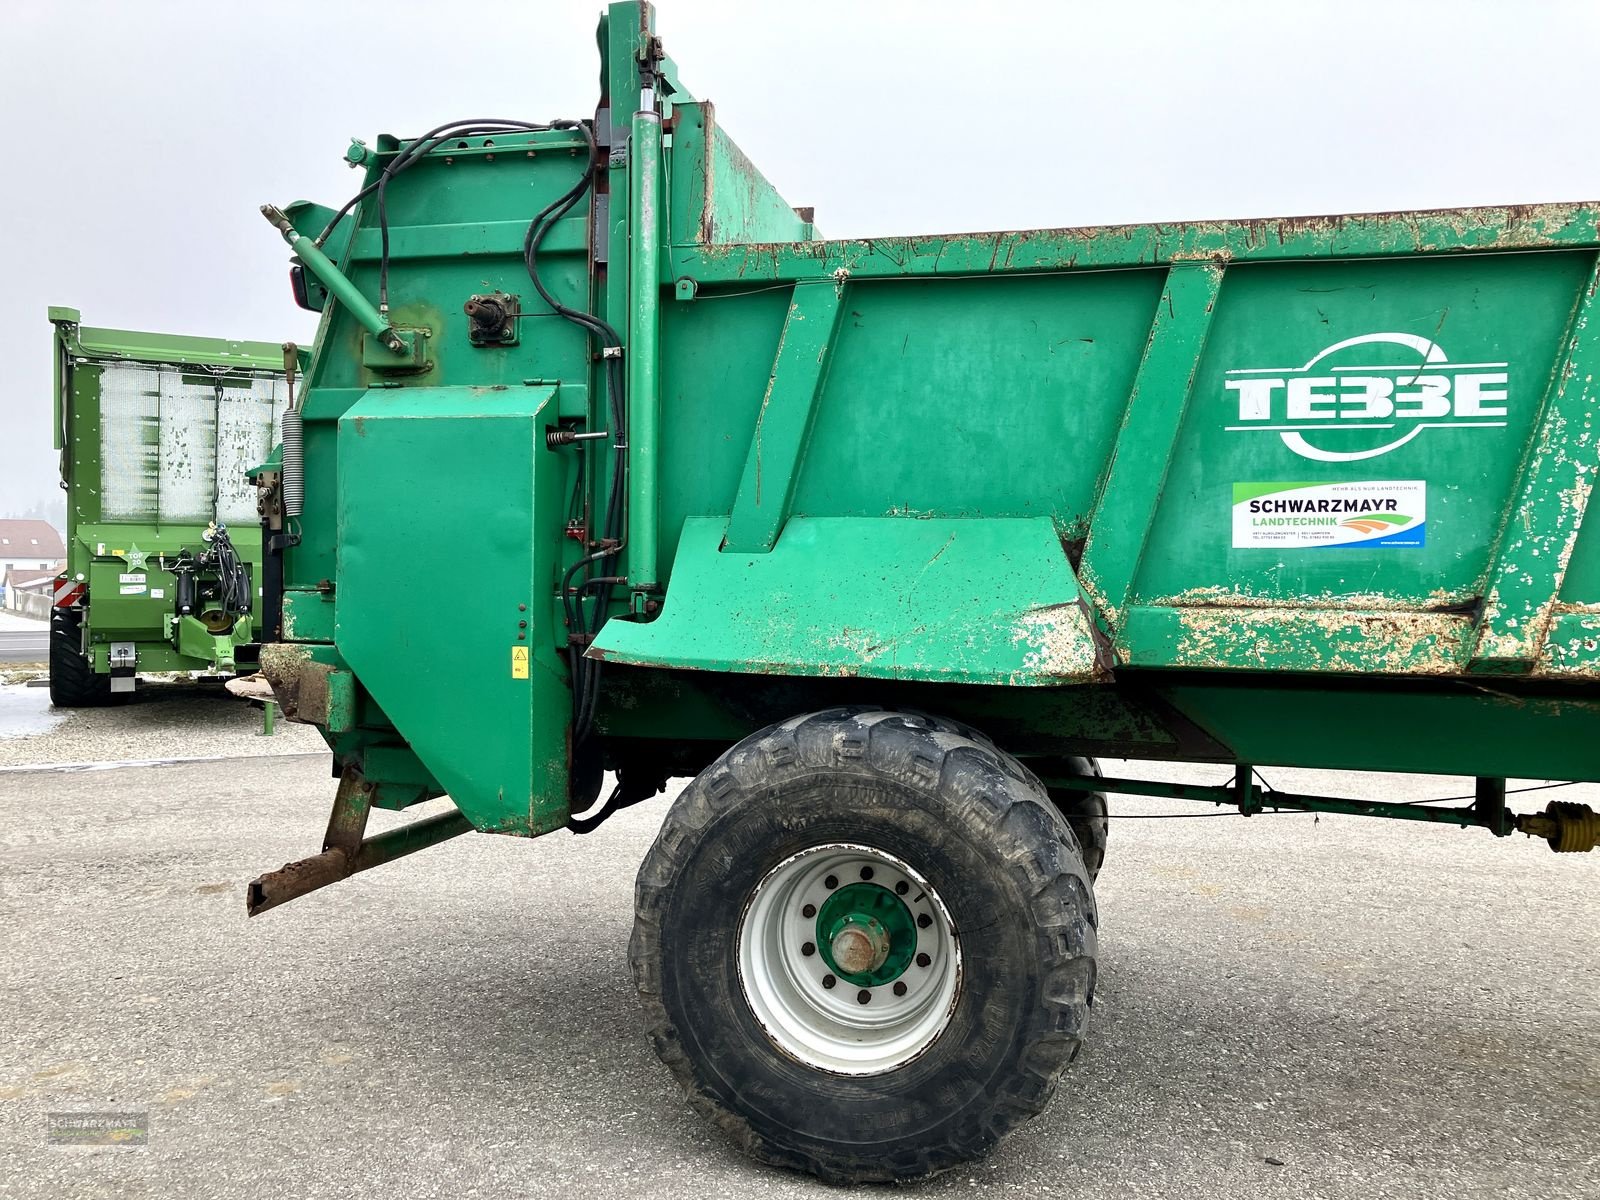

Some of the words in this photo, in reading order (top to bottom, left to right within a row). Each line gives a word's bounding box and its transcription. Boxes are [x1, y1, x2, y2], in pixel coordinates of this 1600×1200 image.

[1225, 373, 1508, 421] TEBBE
[1250, 498, 1398, 514] SCHWARZMAYR
[1252, 516, 1339, 527] LANDTECHNIK
